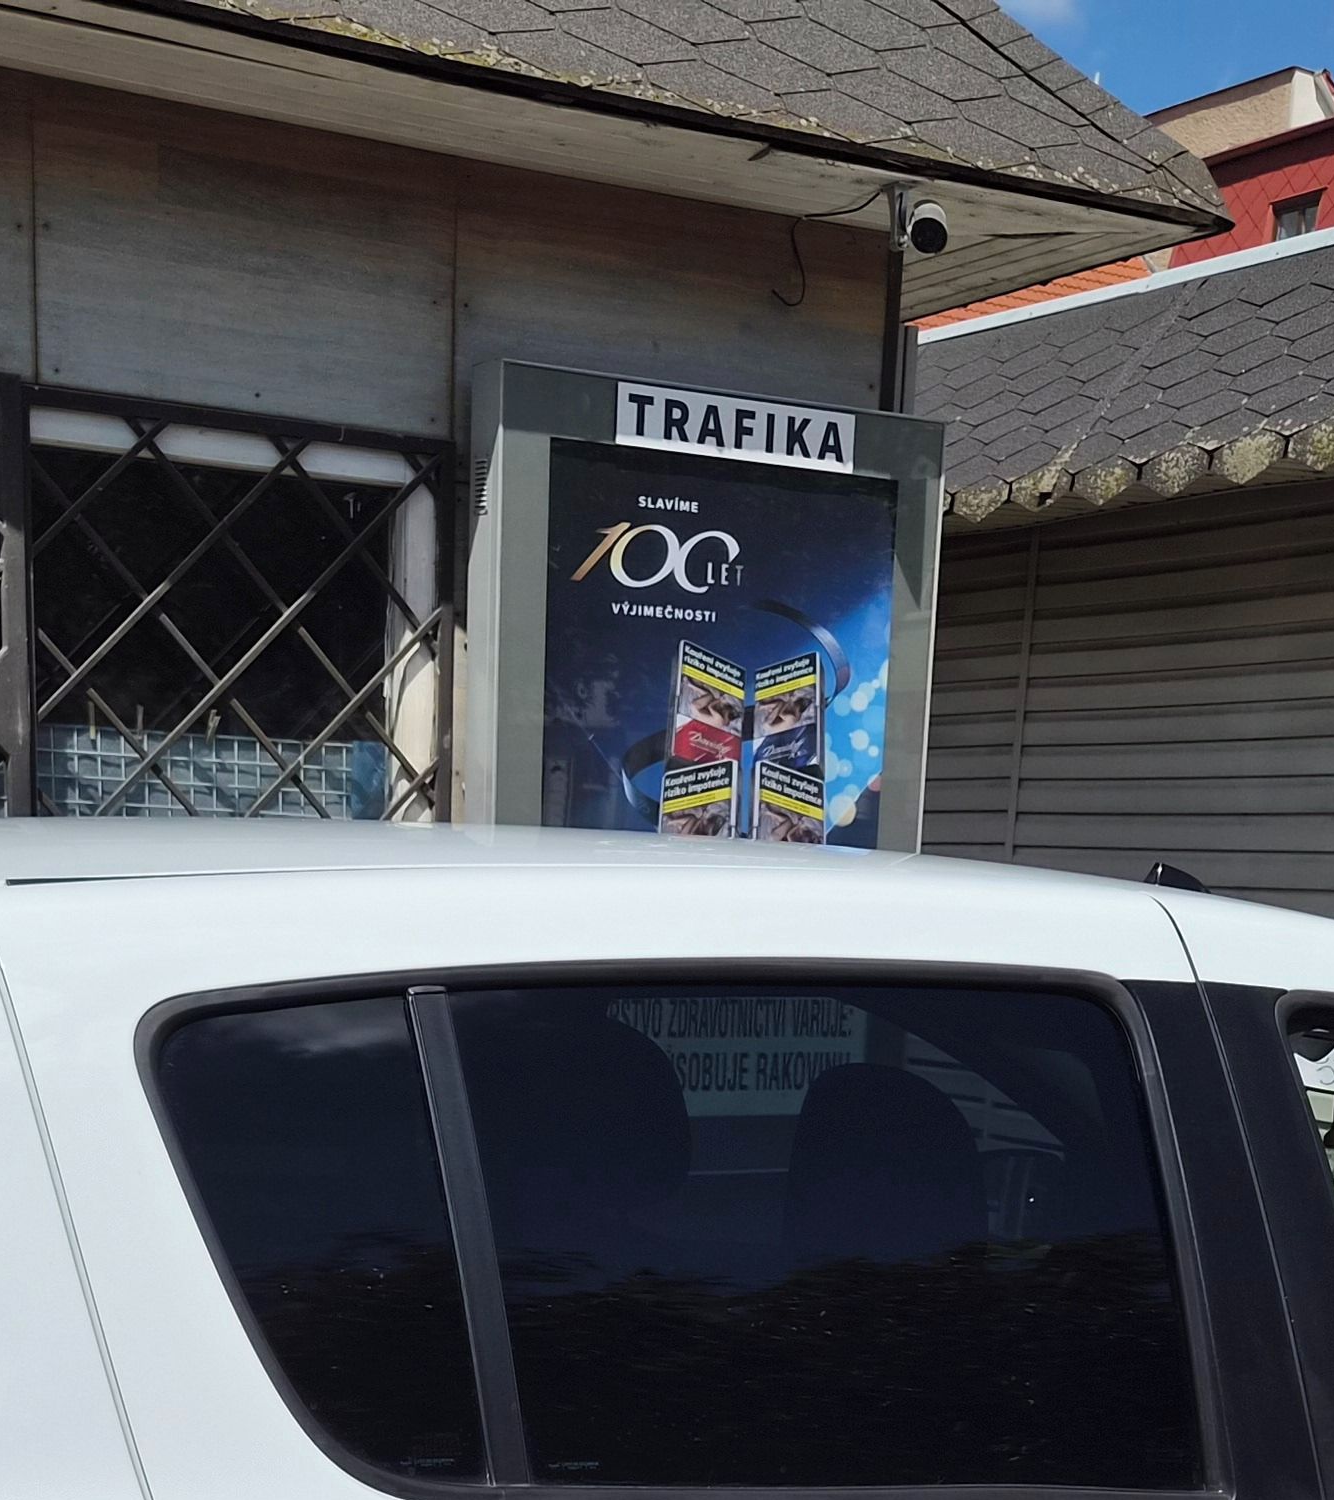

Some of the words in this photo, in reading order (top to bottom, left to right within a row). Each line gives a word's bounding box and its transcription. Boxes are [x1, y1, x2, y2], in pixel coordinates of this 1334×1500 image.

[628, 393, 845, 463] TRAFIKA
[638, 495, 699, 514] SLAVÍME
[570, 521, 741, 594] 100
[706, 562, 744, 586] LET
[611, 601, 716, 623] VÝJIMEČNOSTI
[755, 1051, 851, 1091] RAKOV
